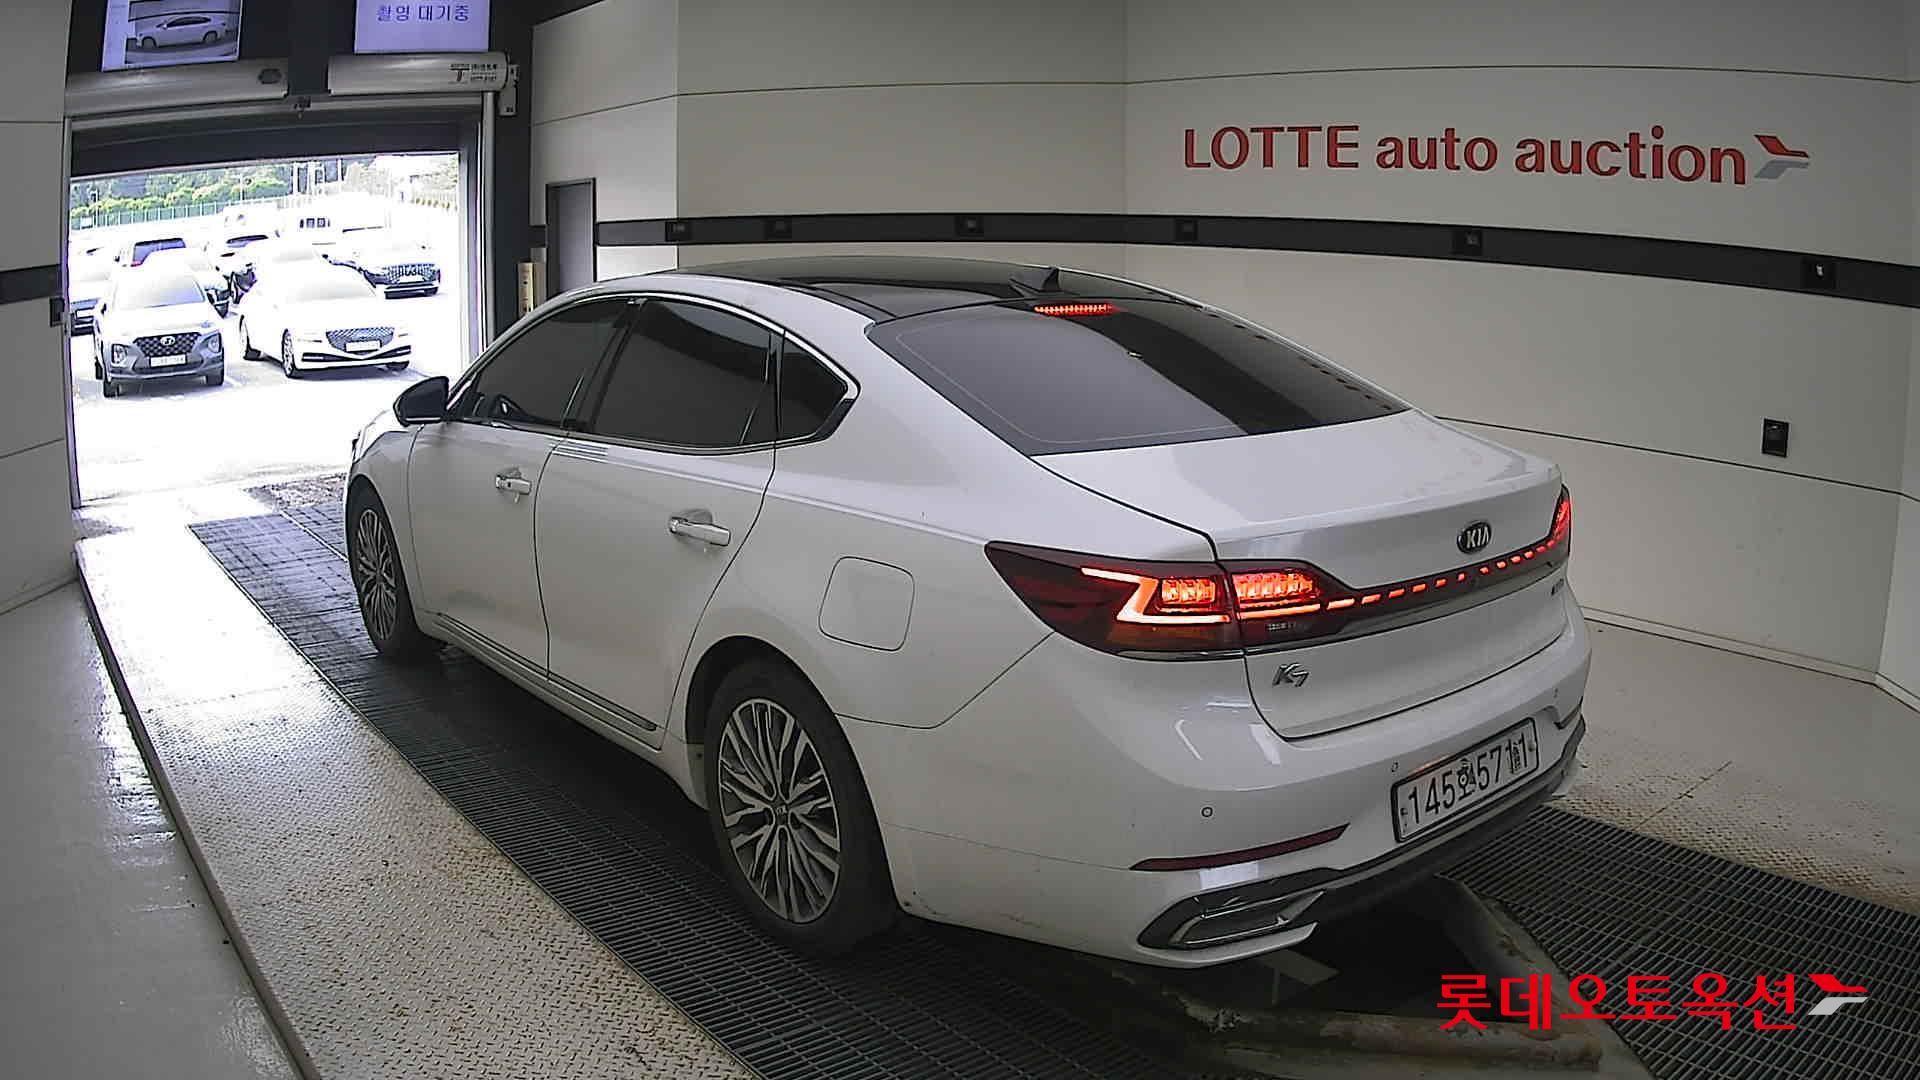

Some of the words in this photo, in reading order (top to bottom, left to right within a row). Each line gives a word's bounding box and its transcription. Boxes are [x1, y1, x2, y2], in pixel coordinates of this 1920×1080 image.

[418, 5, 469, 22] 대기중
[1184, 125, 1360, 169] LOTTE
[1376, 128, 1498, 171] auto
[1515, 125, 1746, 185] auction
[1466, 526, 1489, 549] KIA
[1272, 662, 1310, 688] K7
